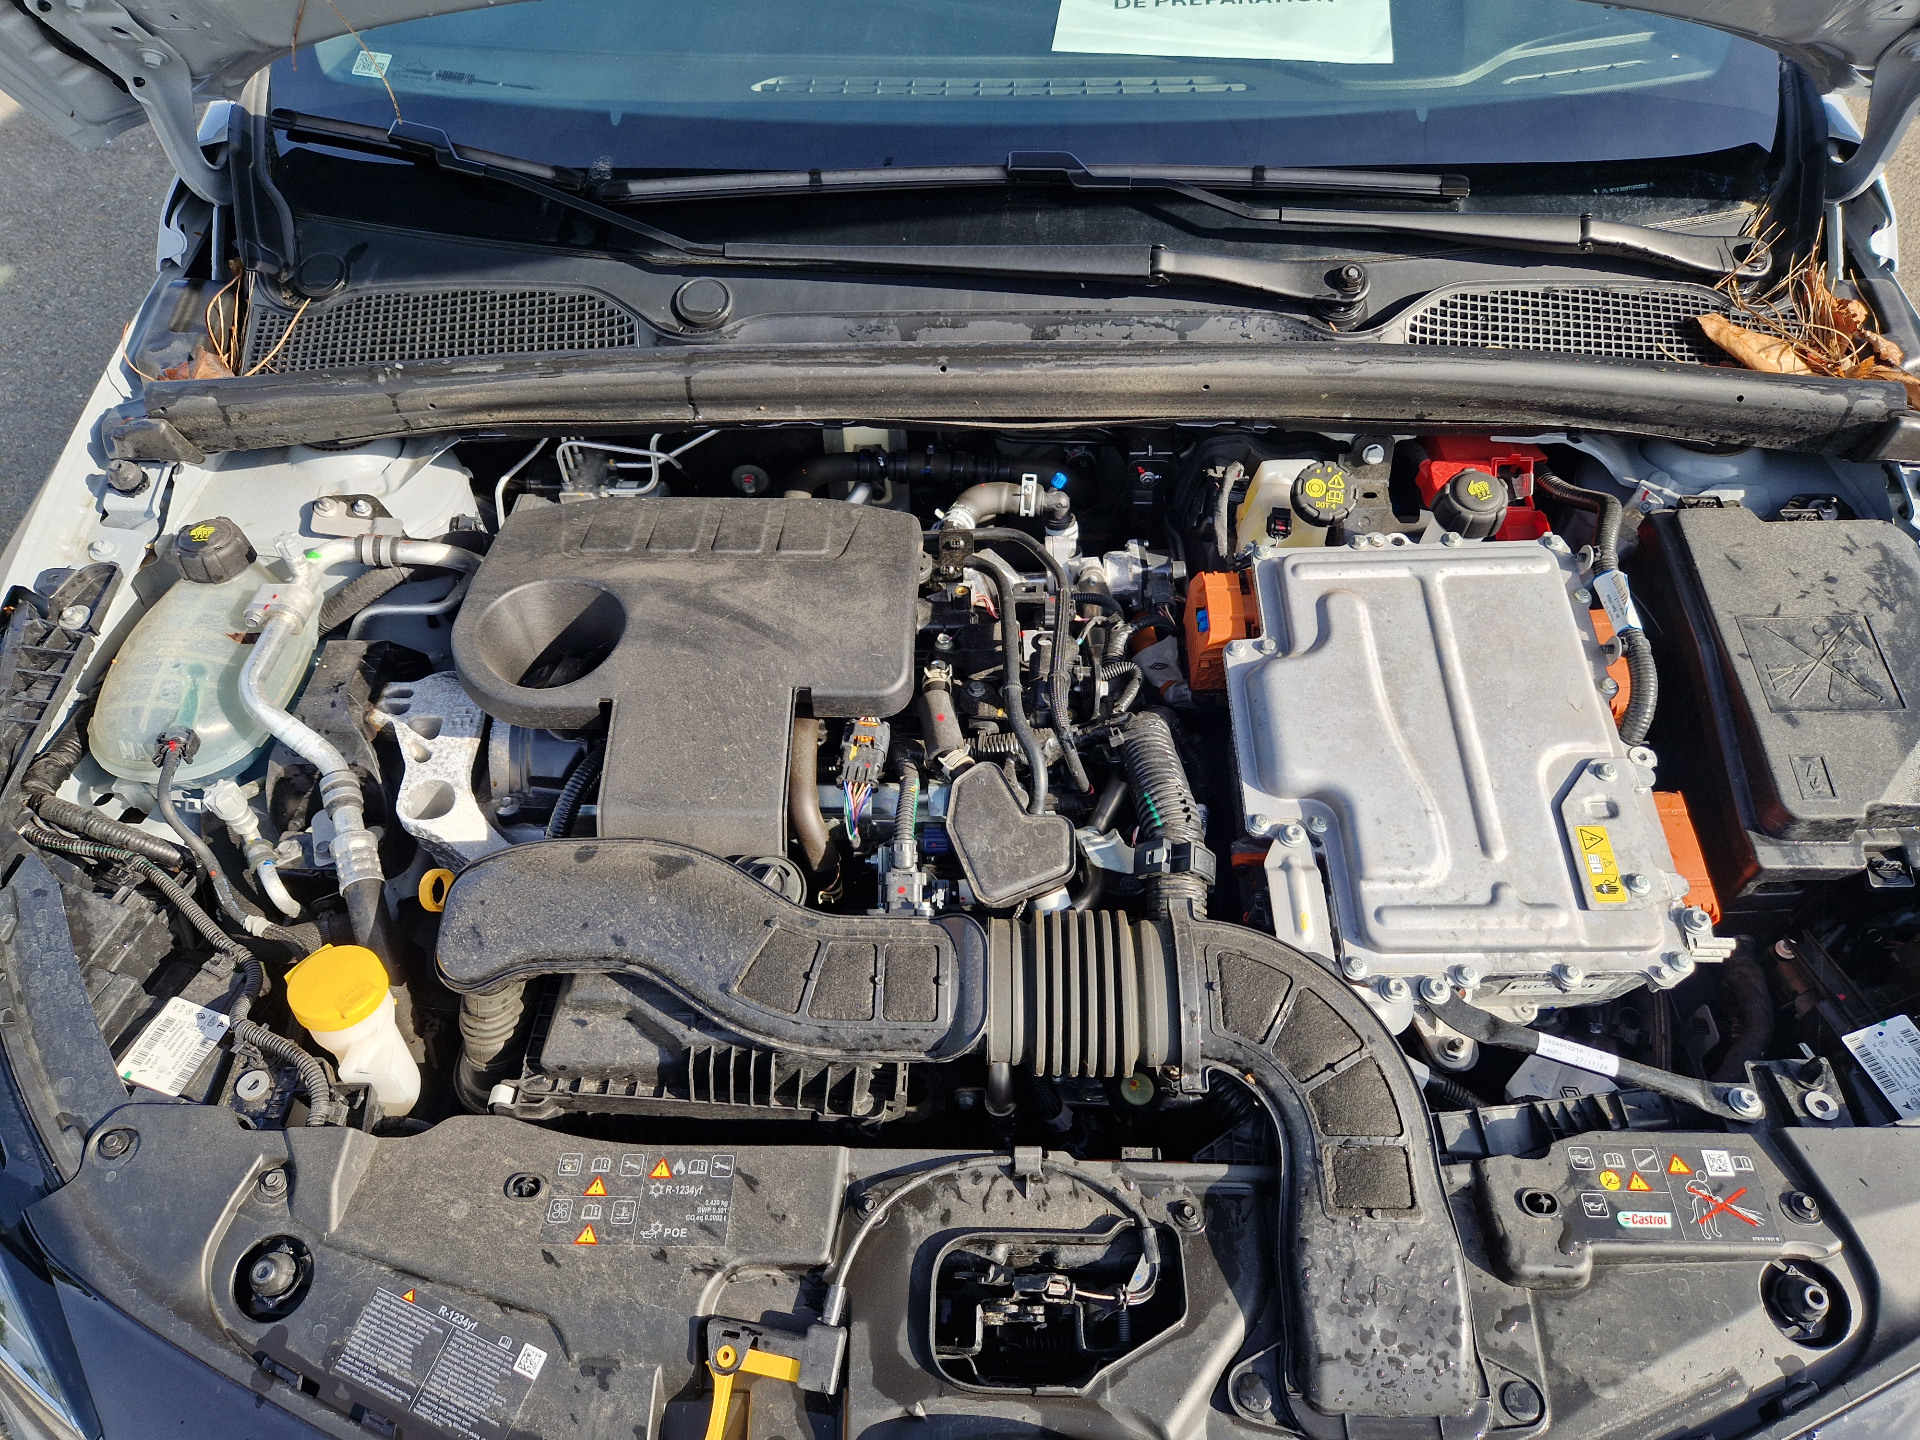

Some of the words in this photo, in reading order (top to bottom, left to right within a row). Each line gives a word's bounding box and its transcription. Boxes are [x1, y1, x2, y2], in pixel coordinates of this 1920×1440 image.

[1114, 0, 1146, 9] DE
[1315, 501, 1330, 509] DOT
[665, 1184, 703, 1196] R-1234yf
[1631, 1213, 1668, 1225] Castrol
[663, 1228, 687, 1238] POE
[437, 1305, 479, 1331] R-1234yf
